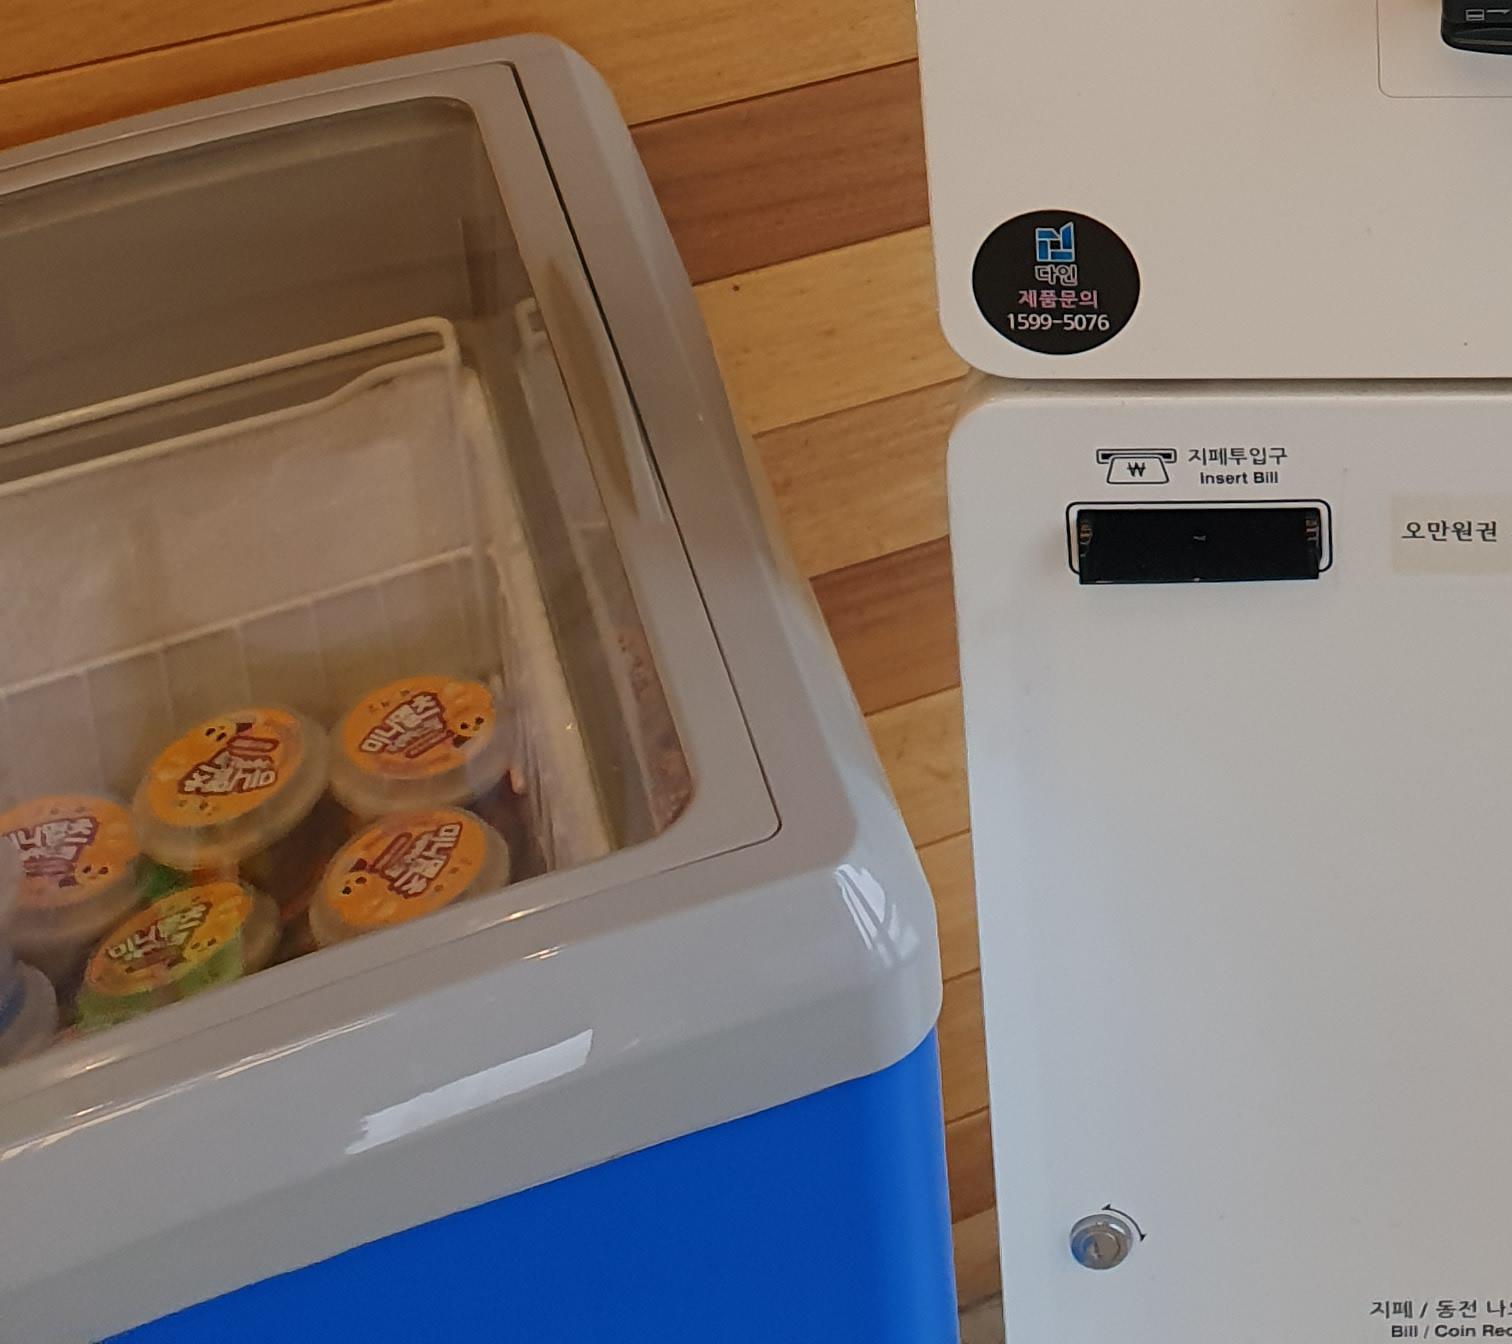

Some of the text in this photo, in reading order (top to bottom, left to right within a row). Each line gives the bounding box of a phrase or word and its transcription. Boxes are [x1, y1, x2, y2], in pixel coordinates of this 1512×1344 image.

[1035, 264, 1077, 286] 다인
[1019, 290, 1097, 309] 제품문의
[1008, 314, 1109, 330] 1599-5076
[1189, 448, 1288, 466] 지폐투입구
[1200, 472, 1278, 484] Insert Bill
[1402, 520, 1496, 542] 오만원권
[1370, 1301, 1412, 1319] 지폐
[1436, 1300, 1476, 1318] 동전
[1392, 1325, 1418, 1337] Bill
[1435, 1325, 1476, 1337] Coin
